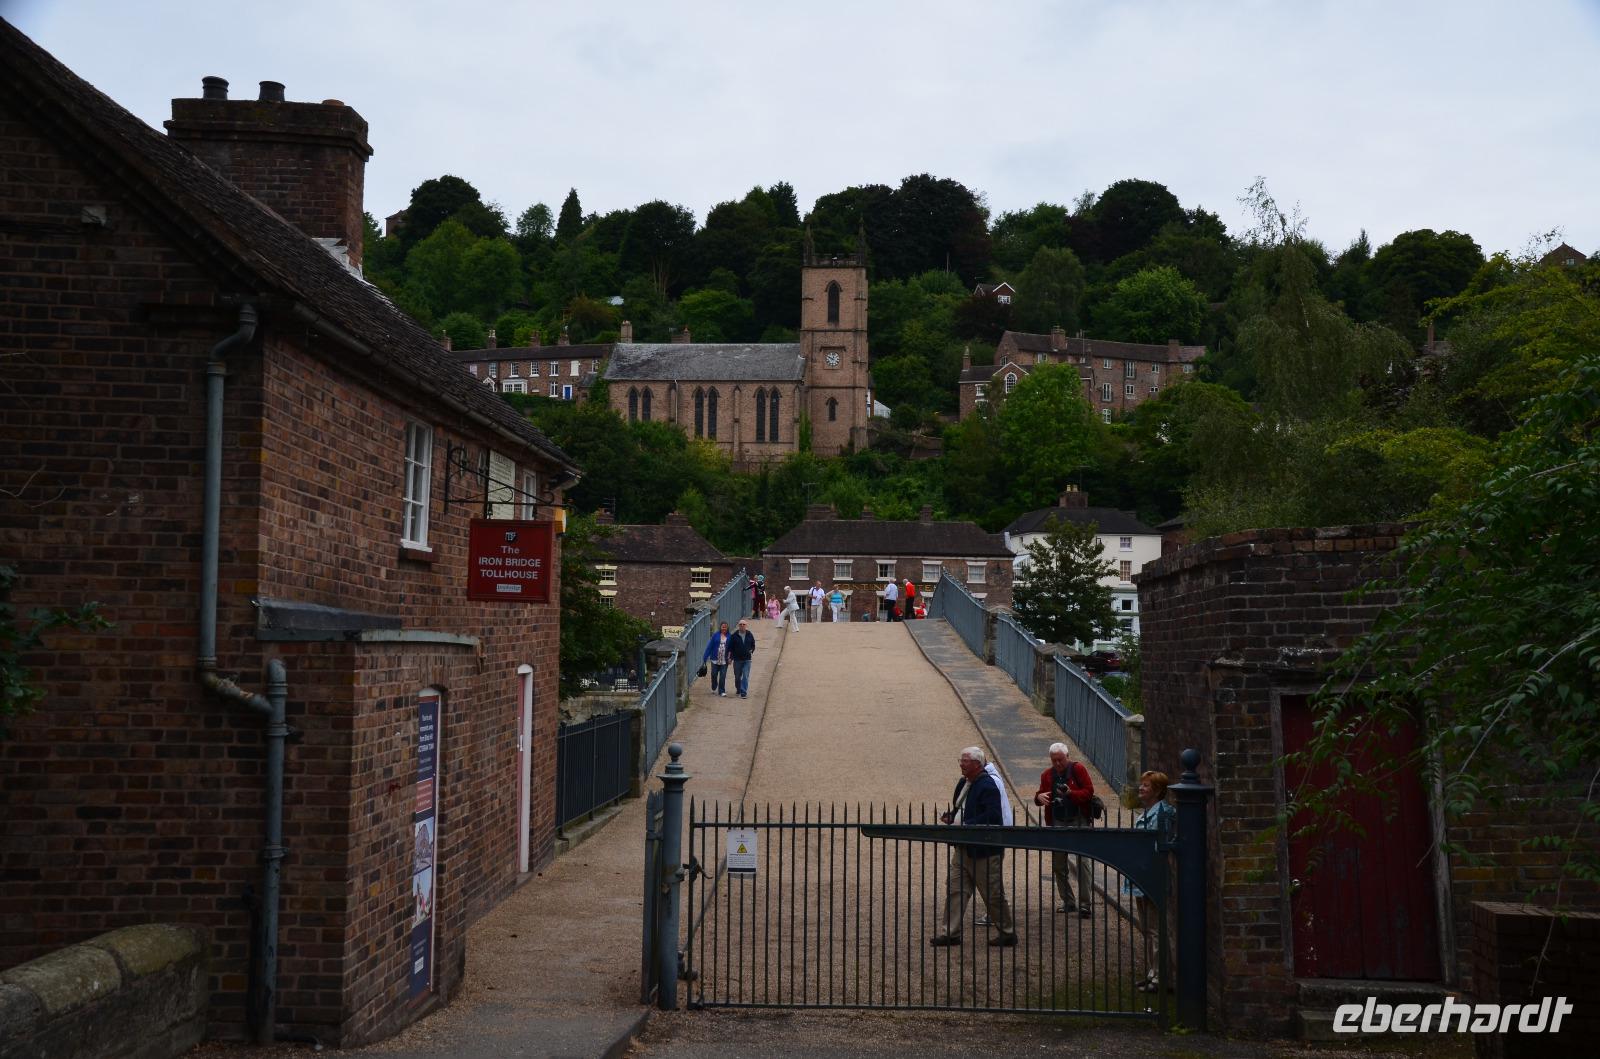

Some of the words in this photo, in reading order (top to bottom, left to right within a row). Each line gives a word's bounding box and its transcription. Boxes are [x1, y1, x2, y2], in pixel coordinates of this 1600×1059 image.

[500, 545, 520, 554] The
[478, 557, 502, 566] IRON
[505, 558, 541, 567] BRIDGE
[480, 569, 539, 580] TOLLHOUSE
